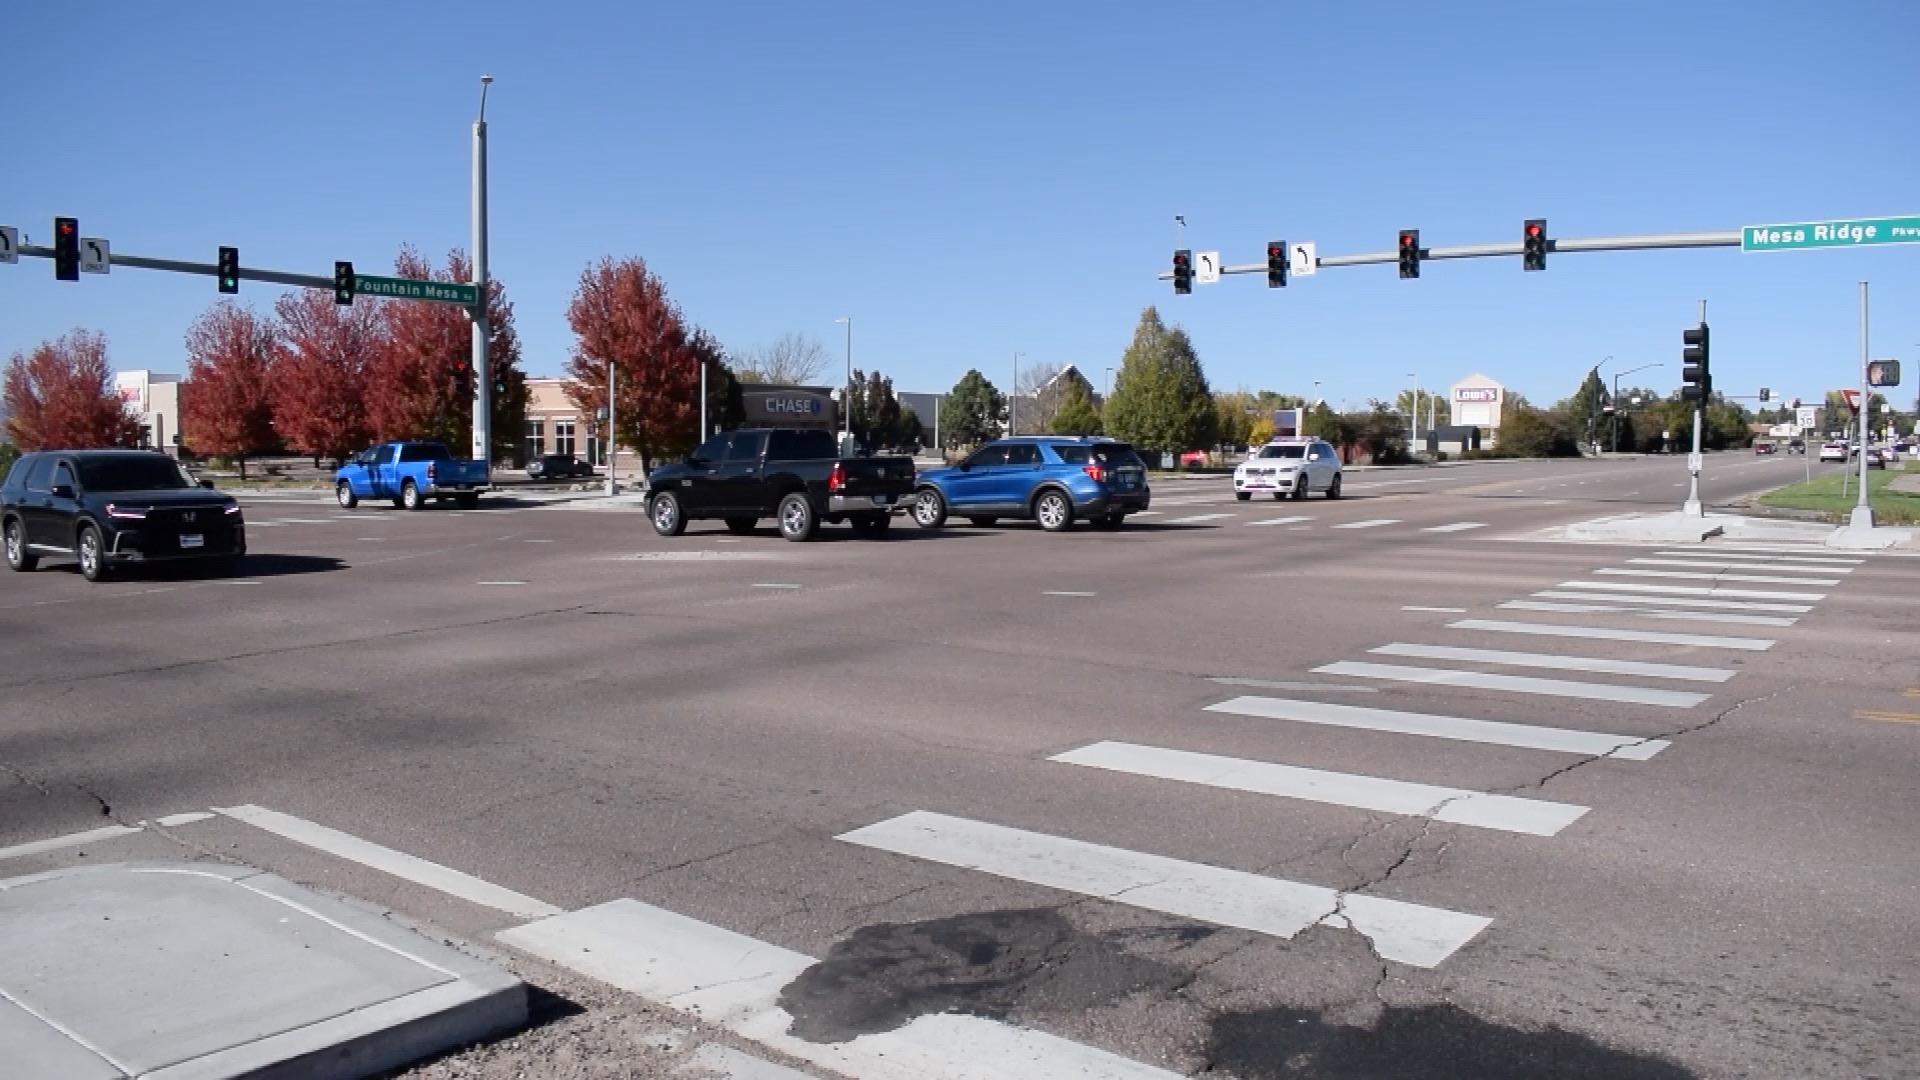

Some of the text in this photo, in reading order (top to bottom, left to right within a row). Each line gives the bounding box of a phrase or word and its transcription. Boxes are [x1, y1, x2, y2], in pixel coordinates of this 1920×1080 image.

[1753, 229, 1805, 245] Mesa
[1814, 224, 1877, 243] Ridge
[355, 278, 421, 295] Fountain
[425, 285, 458, 299] Mesa
[765, 397, 812, 413] CHASE
